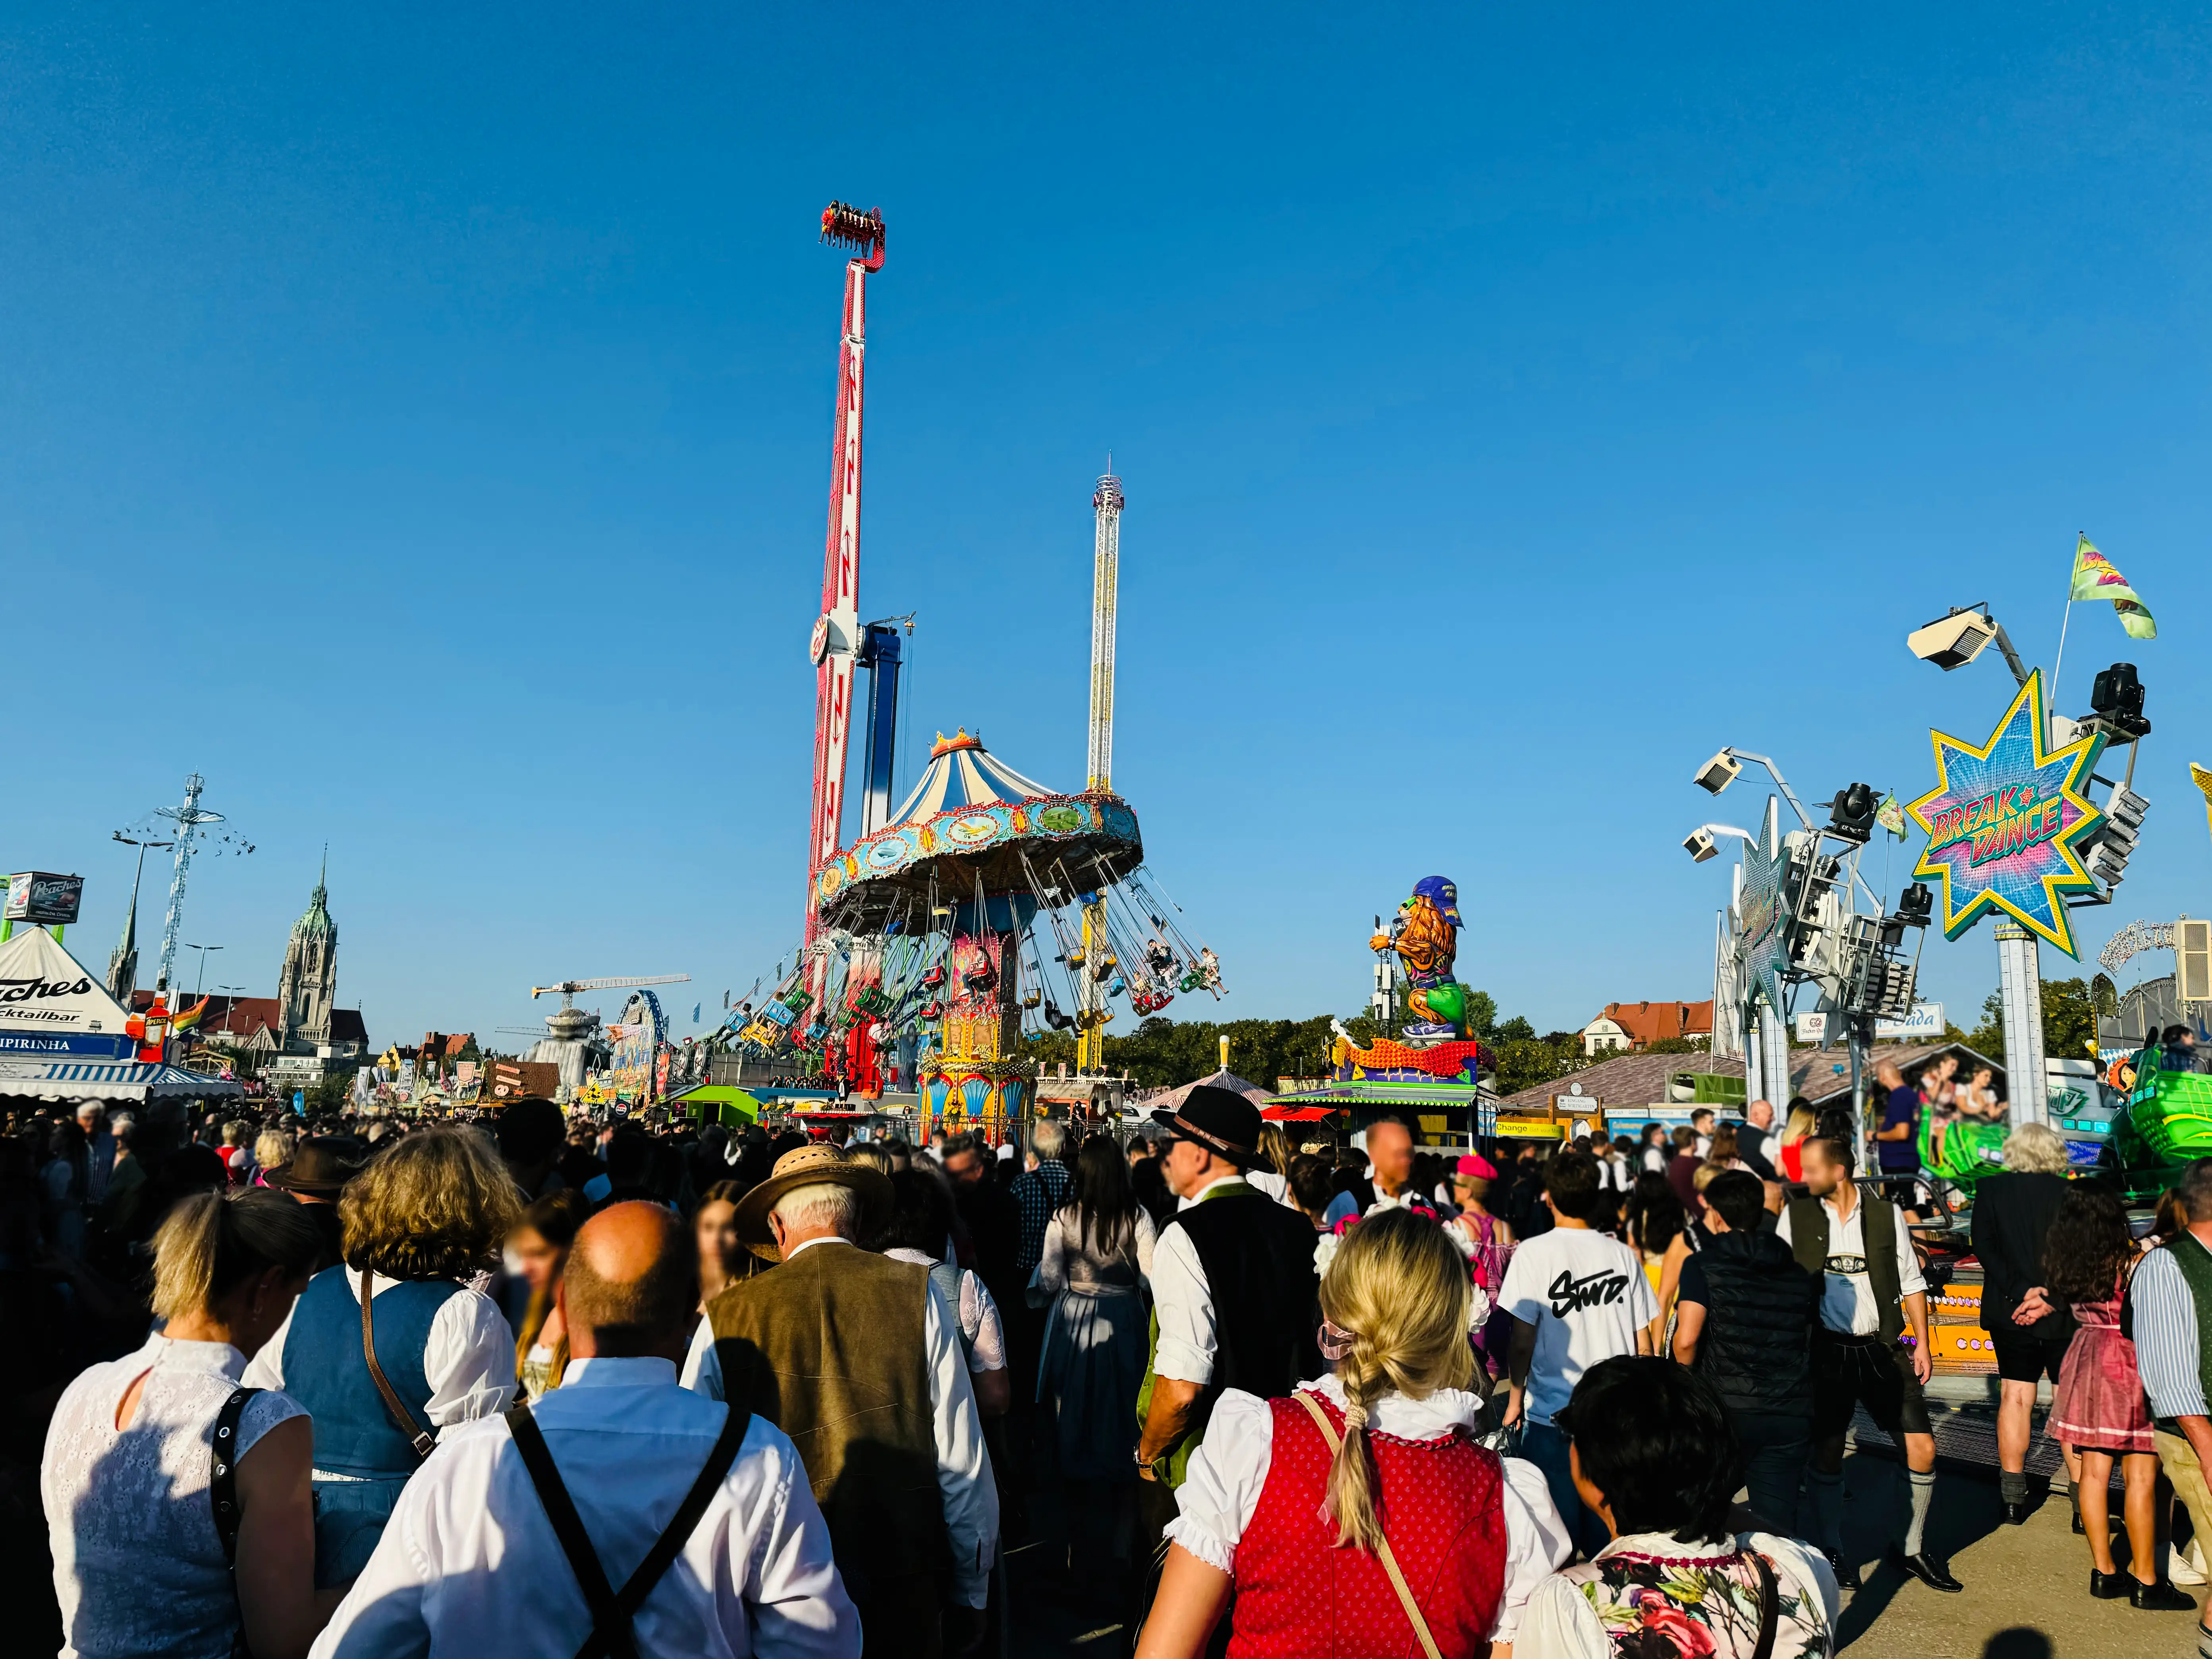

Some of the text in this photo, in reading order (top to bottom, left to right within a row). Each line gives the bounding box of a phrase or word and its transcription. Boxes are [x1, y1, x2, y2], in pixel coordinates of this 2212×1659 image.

[1929, 786, 2019, 851] BREAK
[1967, 795, 2060, 863] DANCE
[33, 878, 82, 900] Peaches
[0, 976, 91, 1002] ches
[1497, 1124, 1527, 1133] Change
